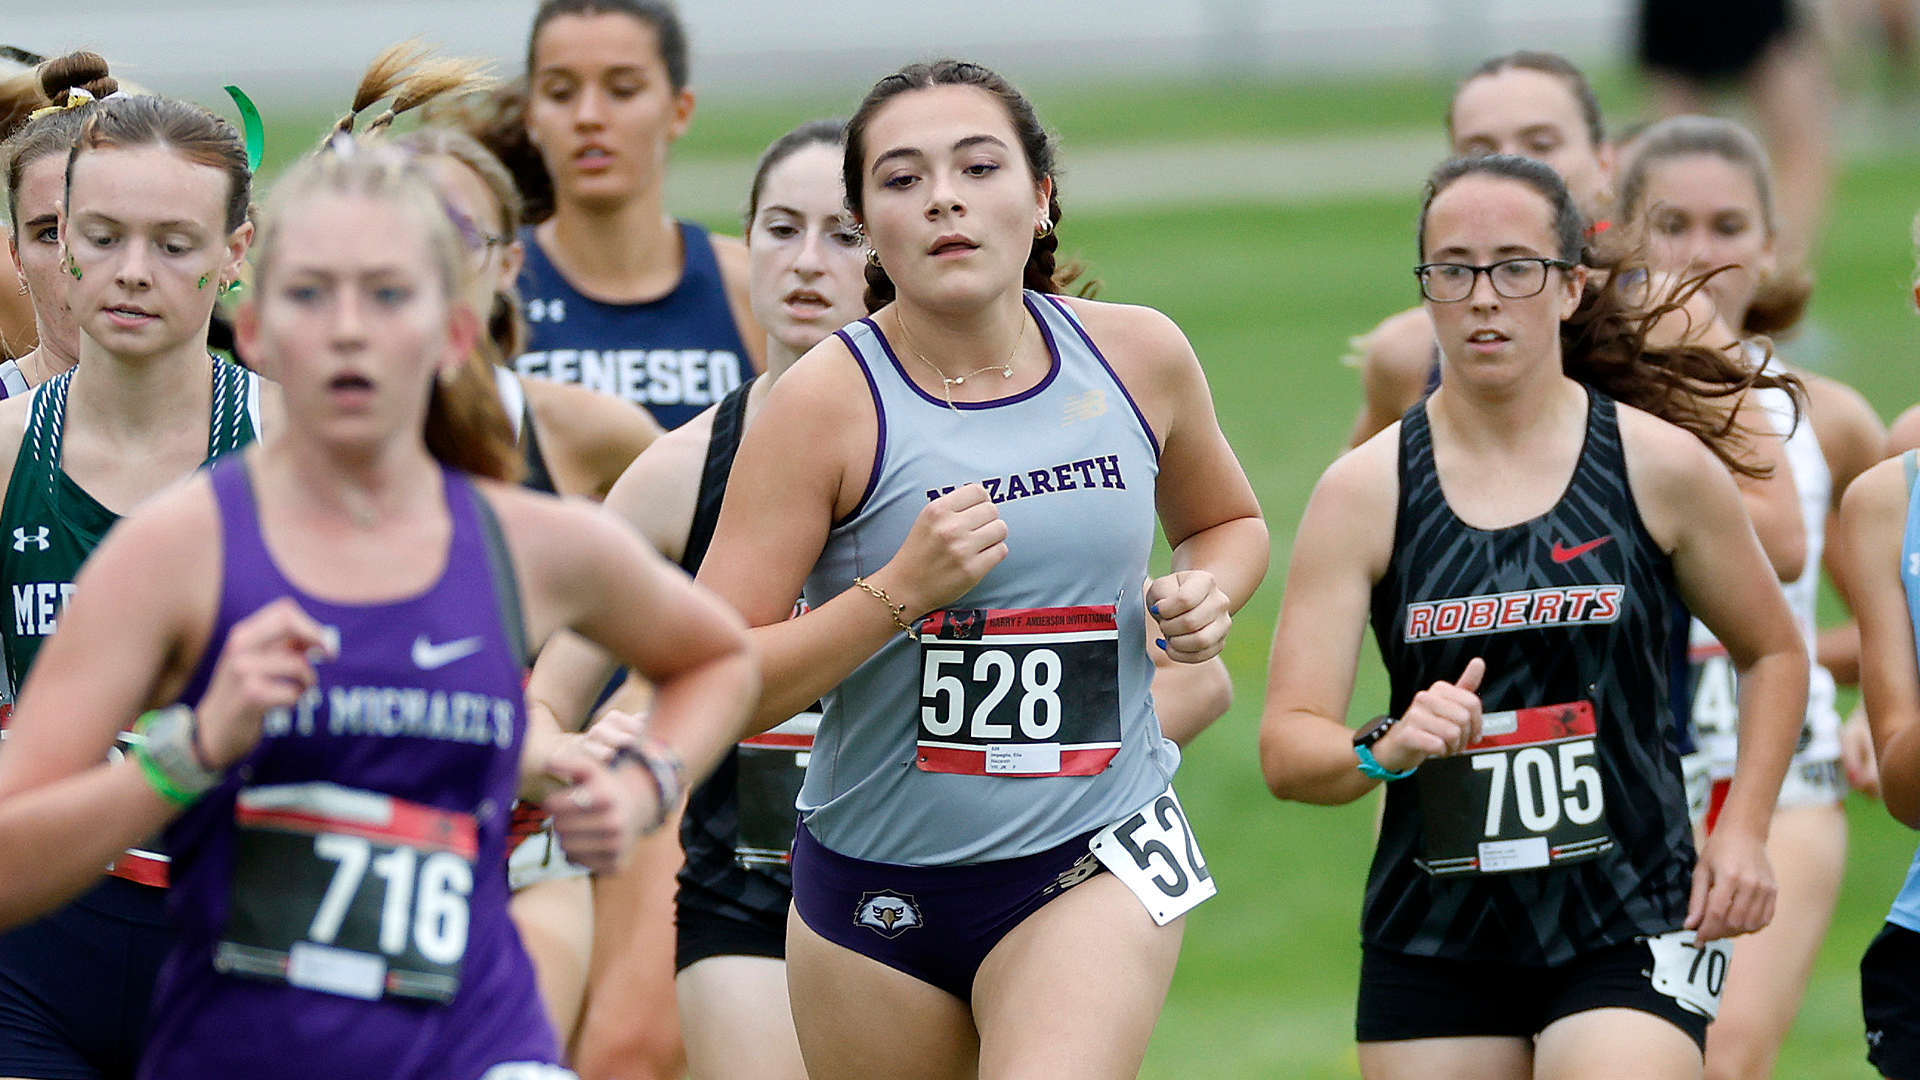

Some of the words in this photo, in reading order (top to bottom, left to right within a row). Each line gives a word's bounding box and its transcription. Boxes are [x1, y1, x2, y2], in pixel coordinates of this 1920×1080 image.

[926, 454, 1126, 505] ZARETH
[1026, 614, 1065, 627] ANDERSON
[1405, 585, 1625, 642] ROBERTS
[921, 648, 1062, 740] 528
[1471, 740, 1604, 837] 705
[1112, 795, 1211, 898] 52
[308, 833, 475, 964] 716
[1681, 942, 1726, 997] 70
